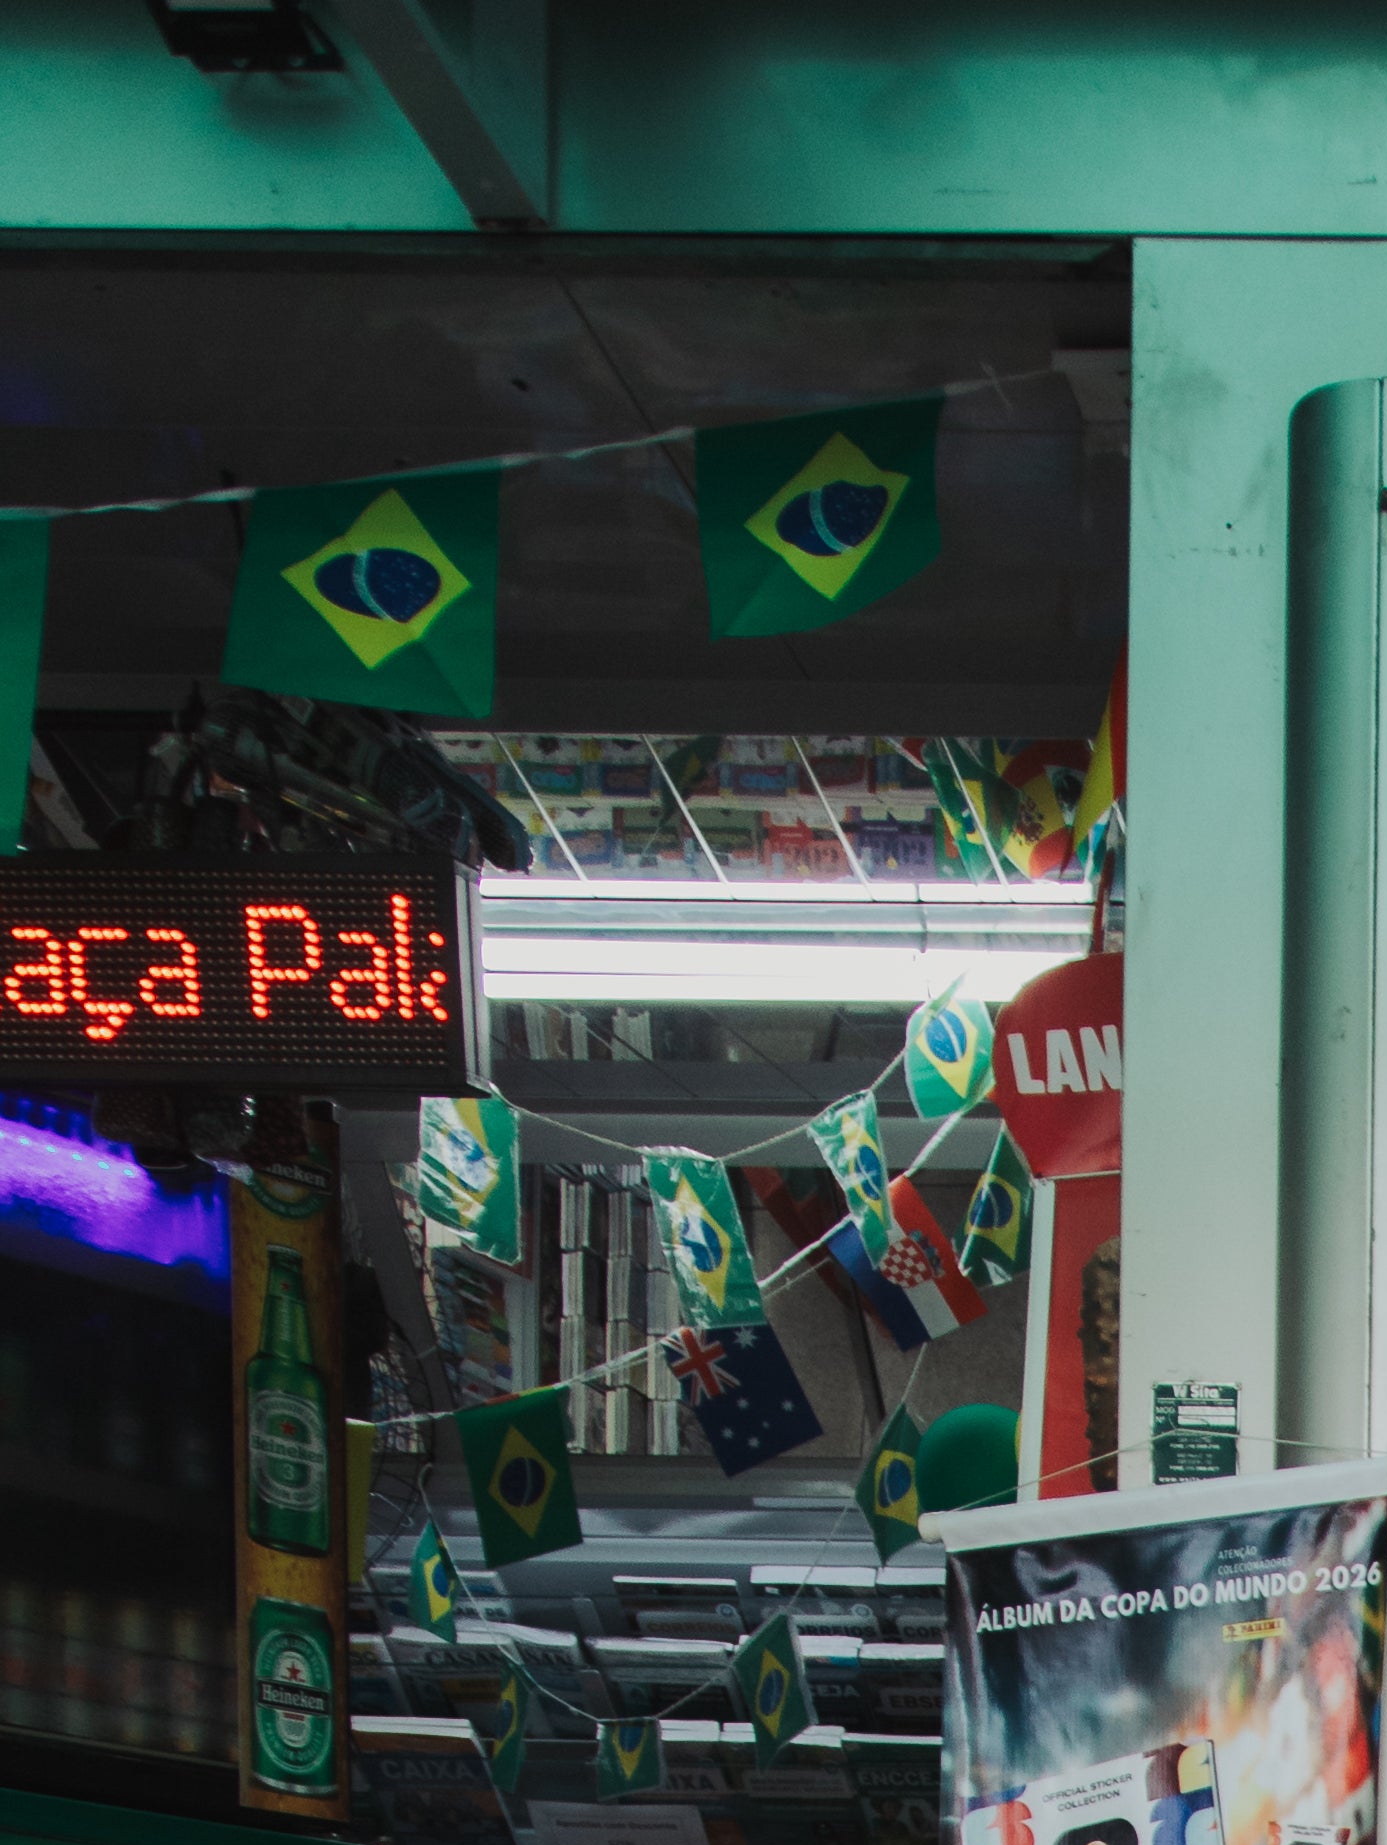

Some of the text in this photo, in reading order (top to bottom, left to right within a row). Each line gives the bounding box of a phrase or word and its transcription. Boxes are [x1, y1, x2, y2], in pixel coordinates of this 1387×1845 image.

[975, 1560, 1382, 1634] ÁLBUM DA COPA DO MUNDO 2026
[260, 1682, 325, 1710] Heineken
[382, 1760, 471, 1781] CAIXA
[1041, 1772, 1134, 1805] OFFICIAL STICKER
[1056, 1790, 1121, 1813] COLLECTION
